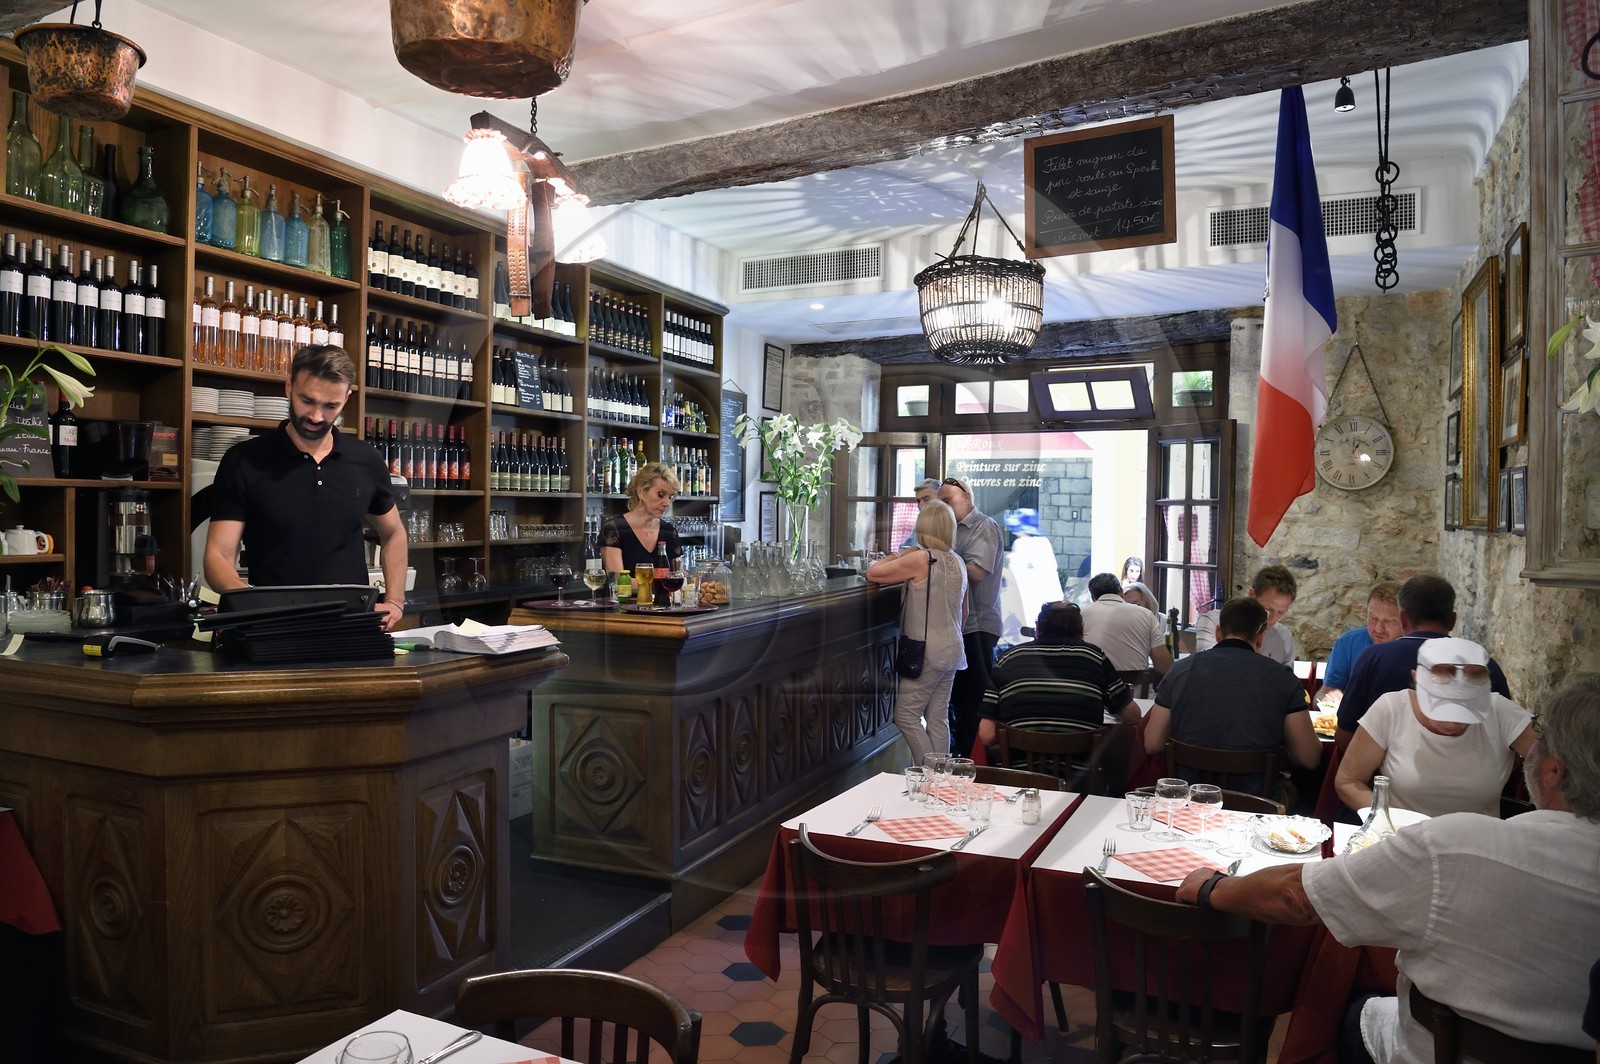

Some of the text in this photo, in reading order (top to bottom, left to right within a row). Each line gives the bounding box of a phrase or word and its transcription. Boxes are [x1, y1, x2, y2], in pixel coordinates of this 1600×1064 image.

[1126, 146, 1148, 157] de
[1045, 180, 1071, 195] porc
[1108, 169, 1125, 177] au
[1126, 159, 1160, 179] Speck
[1068, 183, 1122, 199] et sauge
[1078, 206, 1092, 217] de
[1094, 198, 1137, 219] patate
[22, 444, 52, 455] France
[955, 460, 1047, 473] Peinture sur zinc
[960, 475, 1043, 488] Oeuvres en zinc
